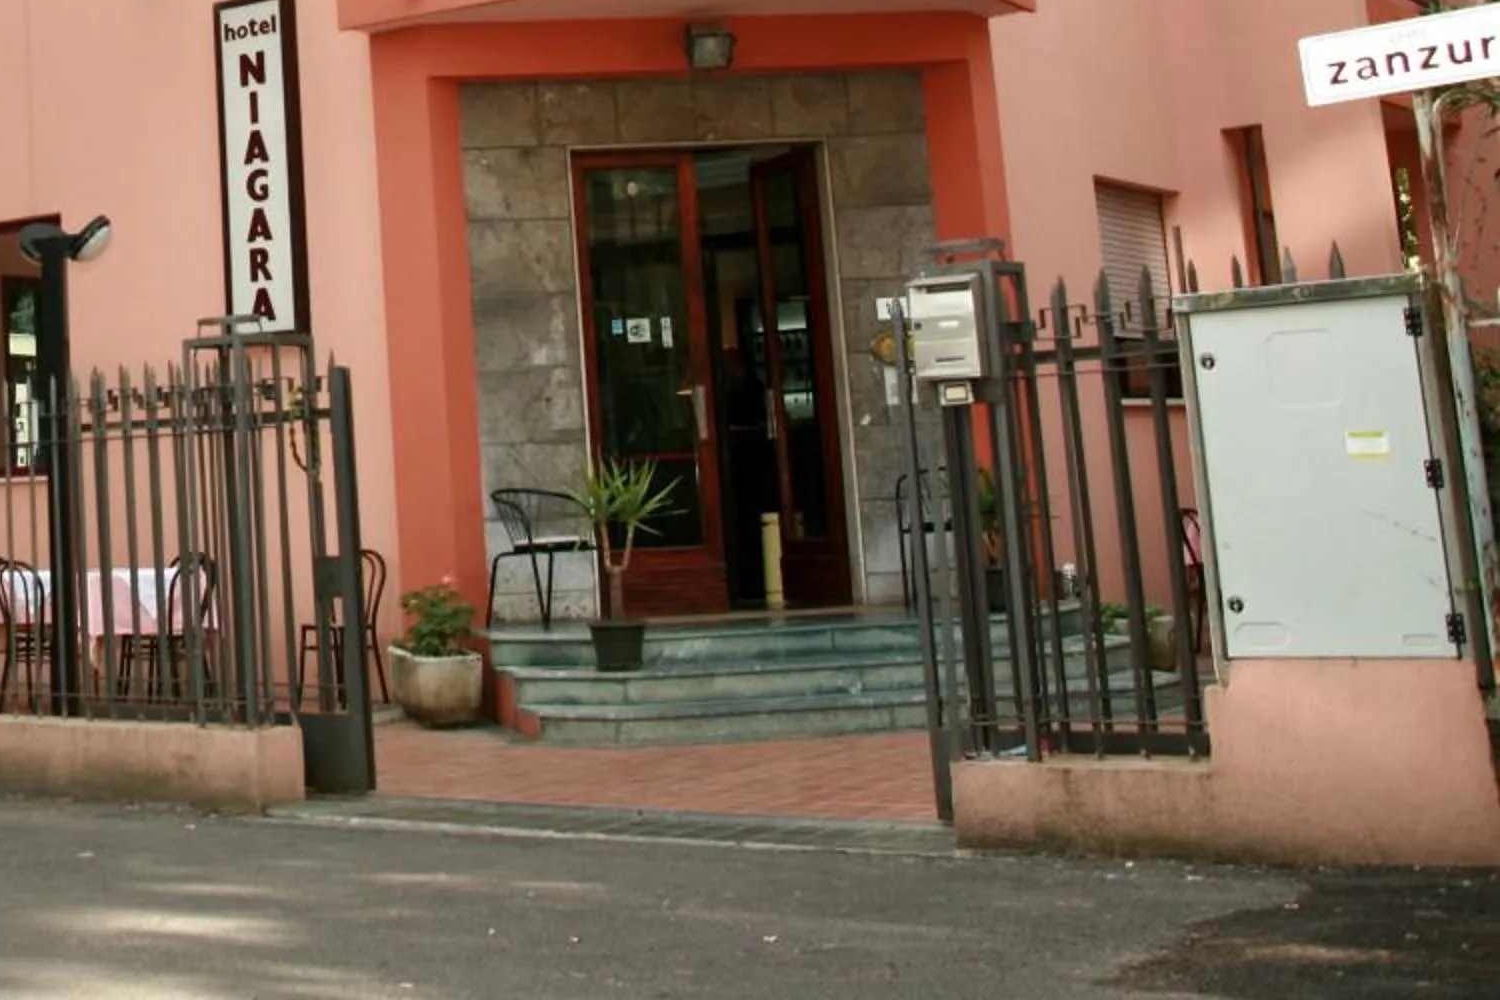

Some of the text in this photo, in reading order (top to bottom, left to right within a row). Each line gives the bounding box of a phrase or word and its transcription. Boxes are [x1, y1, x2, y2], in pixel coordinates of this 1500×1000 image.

[224, 14, 276, 42] hotel
[1327, 34, 1497, 85] zanzur
[238, 50, 276, 322] NIAGARA
